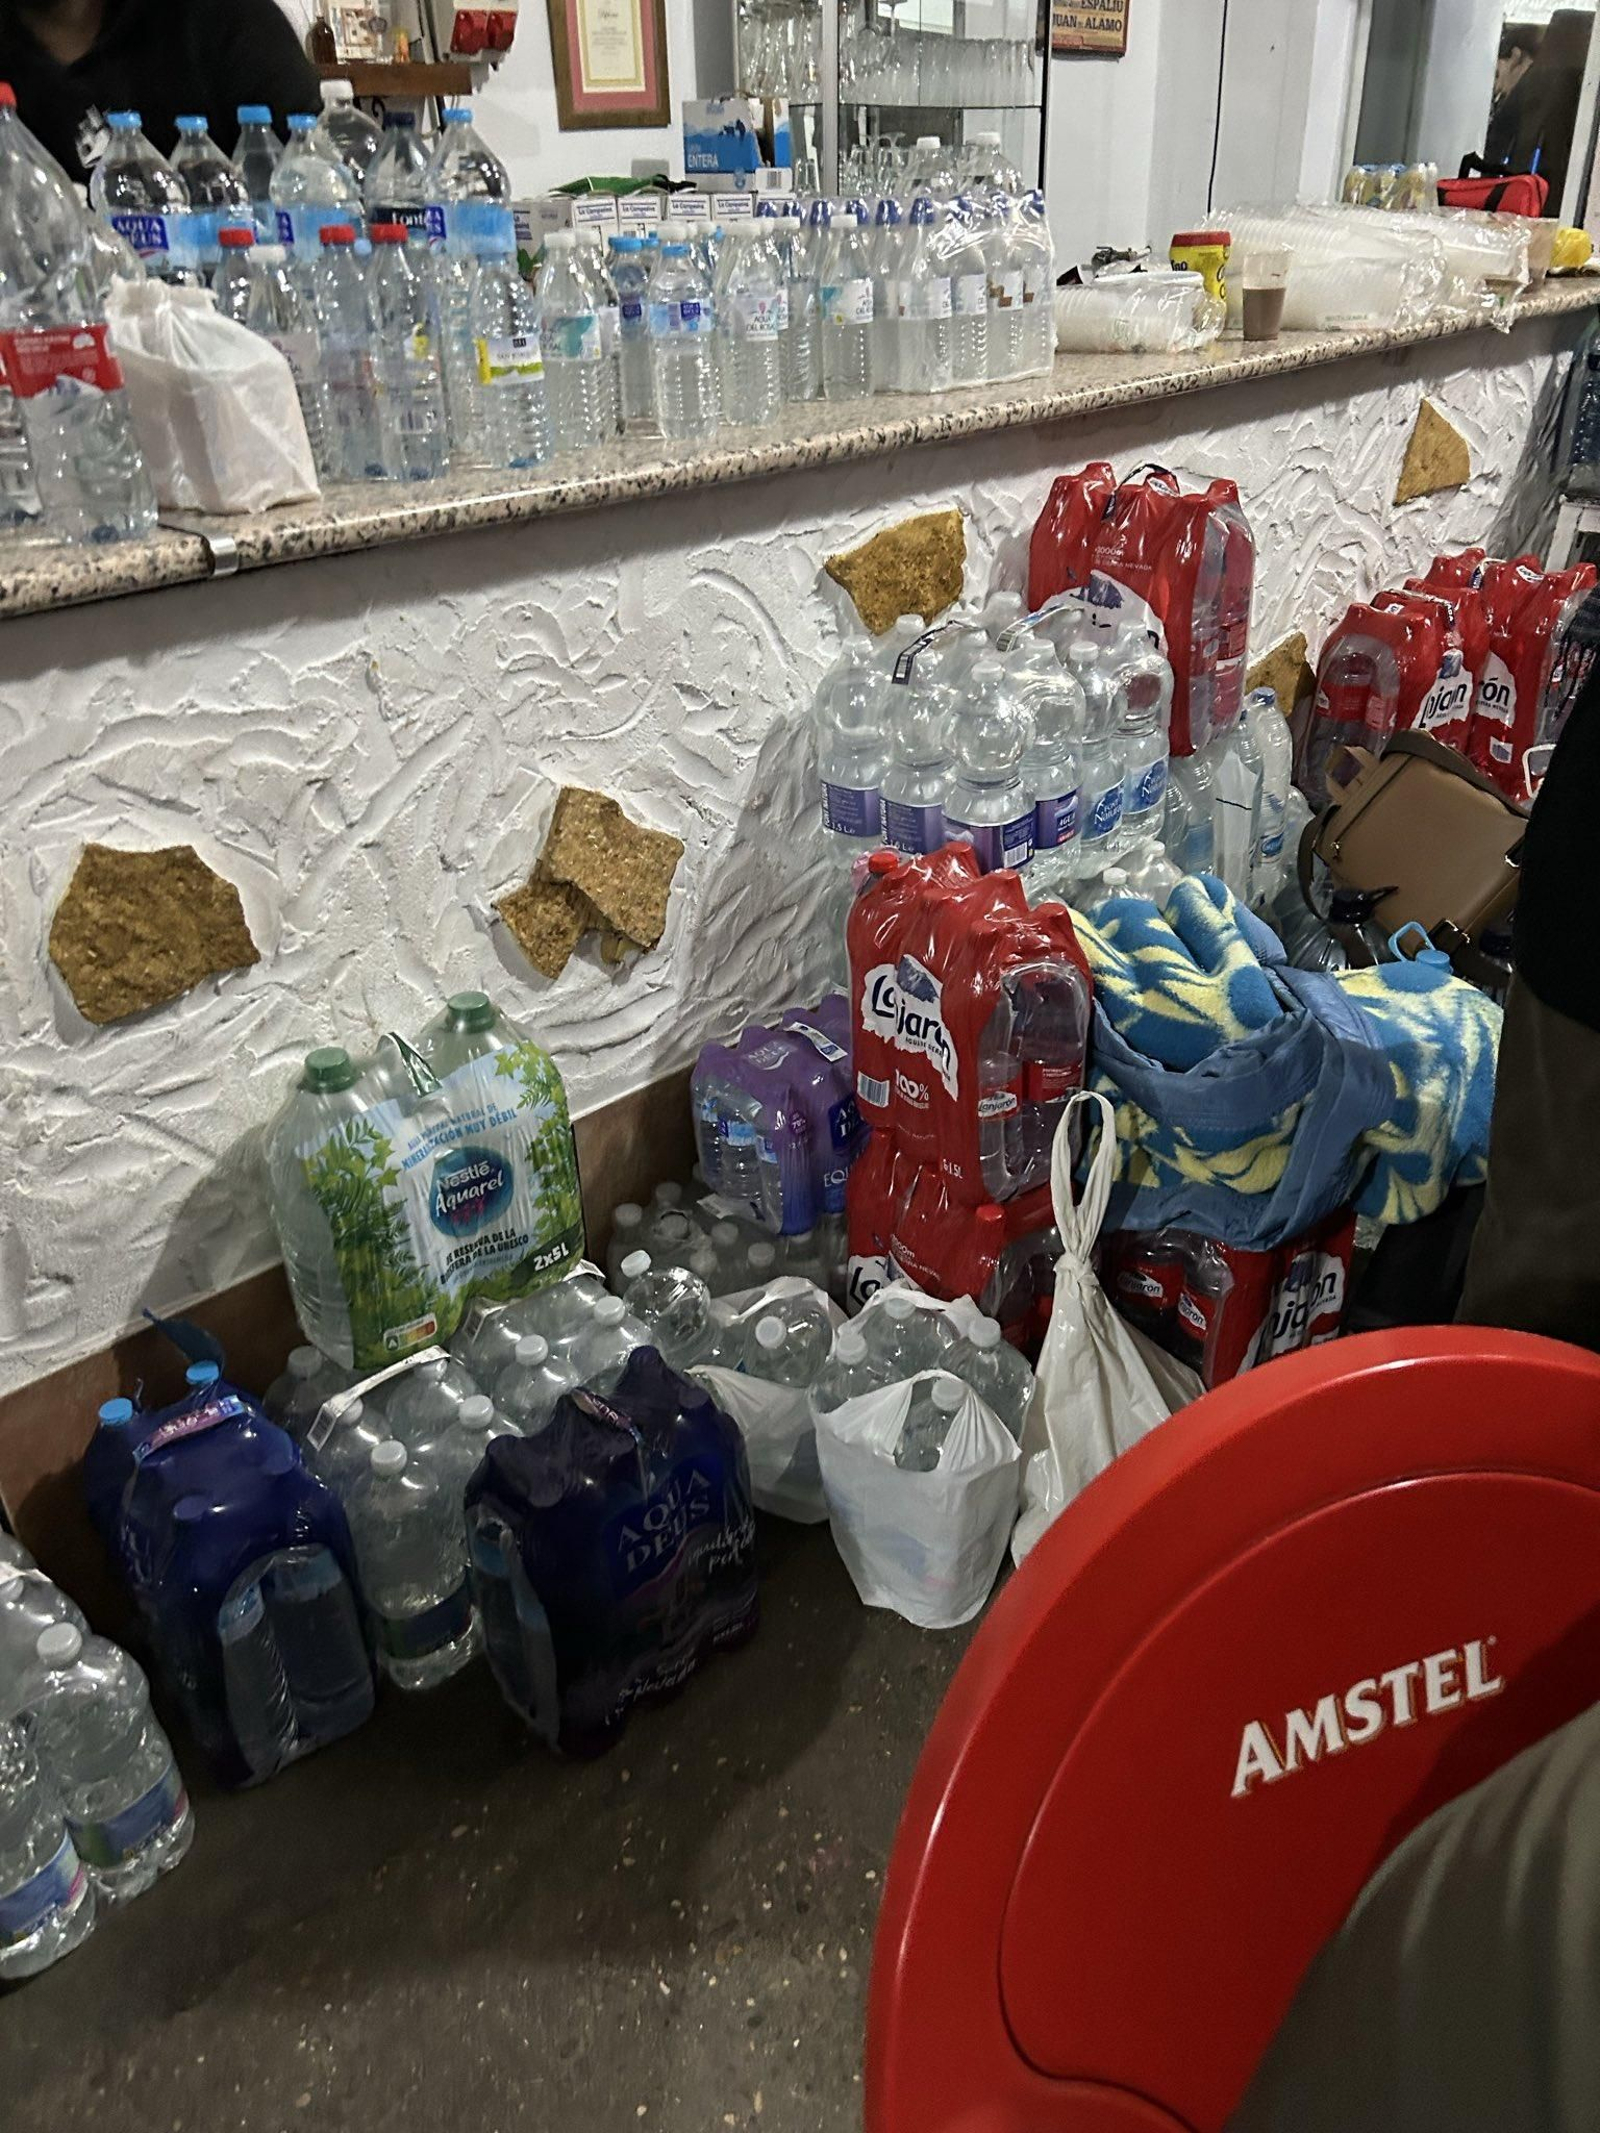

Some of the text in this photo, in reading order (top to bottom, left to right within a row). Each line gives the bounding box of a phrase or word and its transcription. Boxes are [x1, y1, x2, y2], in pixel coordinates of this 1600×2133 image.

[1085, 17, 1123, 32] ALAMO
[686, 152, 719, 169] ENTERA
[116, 218, 161, 234] AQUA
[895, 1067, 929, 1101] 100%
[465, 1121, 487, 1138] MUY
[435, 1169, 504, 1218] Aquarel
[484, 1243, 497, 1256] LA
[497, 1233, 530, 1253] UNESCO
[491, 1231, 505, 1244] DE
[504, 1227, 517, 1240] LA
[533, 1241, 571, 1273] 2x5L
[618, 1468, 711, 1553] AQUA
[626, 1493, 710, 1573] DEUS
[1230, 1639, 1503, 1798] AMSTEL
